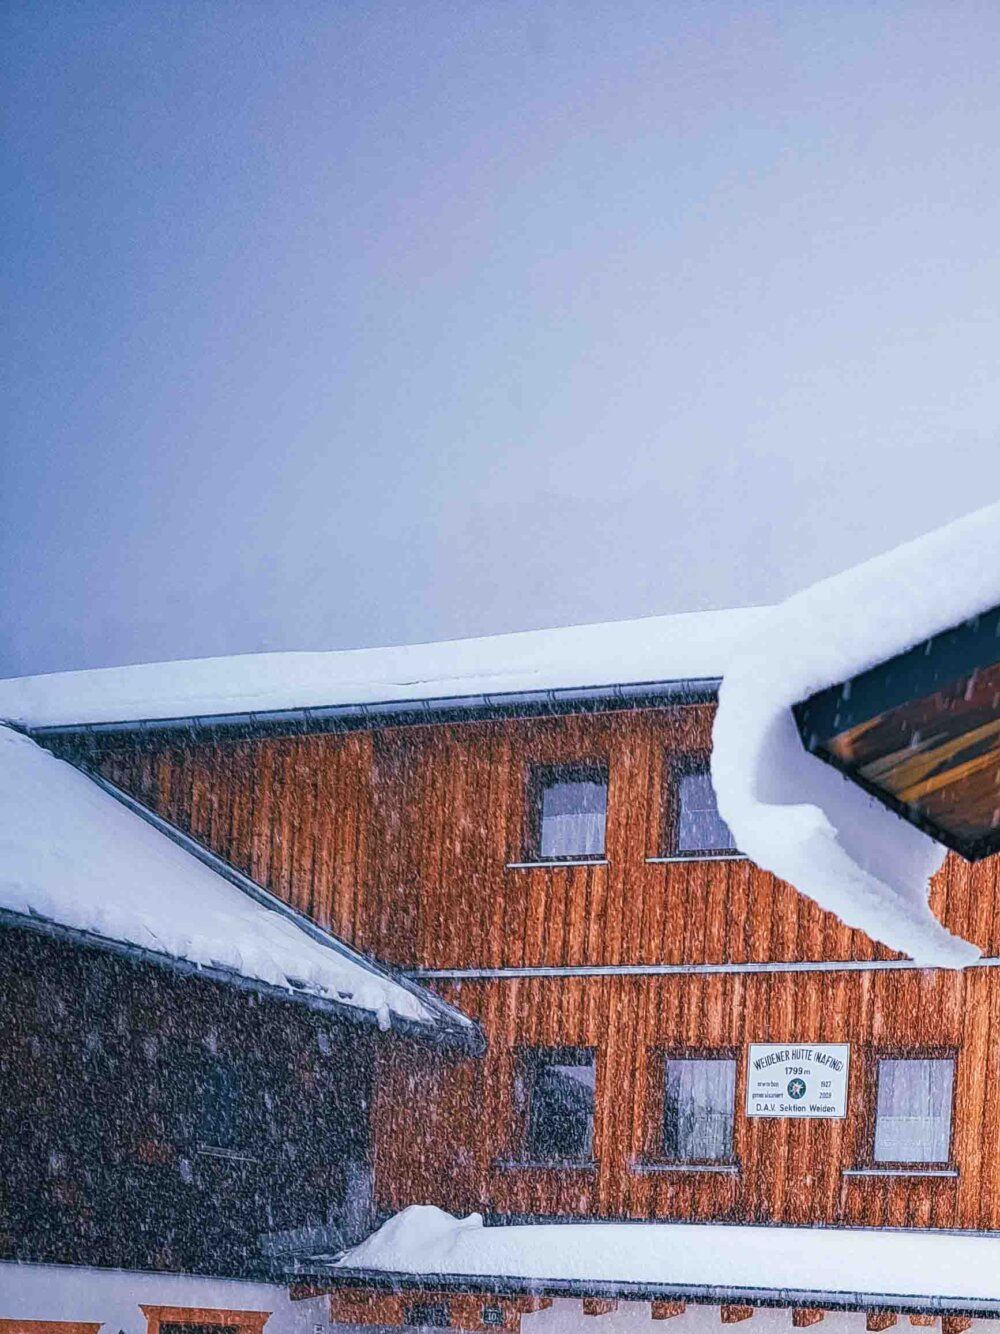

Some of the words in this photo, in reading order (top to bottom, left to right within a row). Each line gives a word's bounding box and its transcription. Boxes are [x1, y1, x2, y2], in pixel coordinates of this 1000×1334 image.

[785, 1067, 803, 1075] 1799
[780, 1104, 807, 1112] Sektion
[809, 1104, 836, 1113] Weiden
